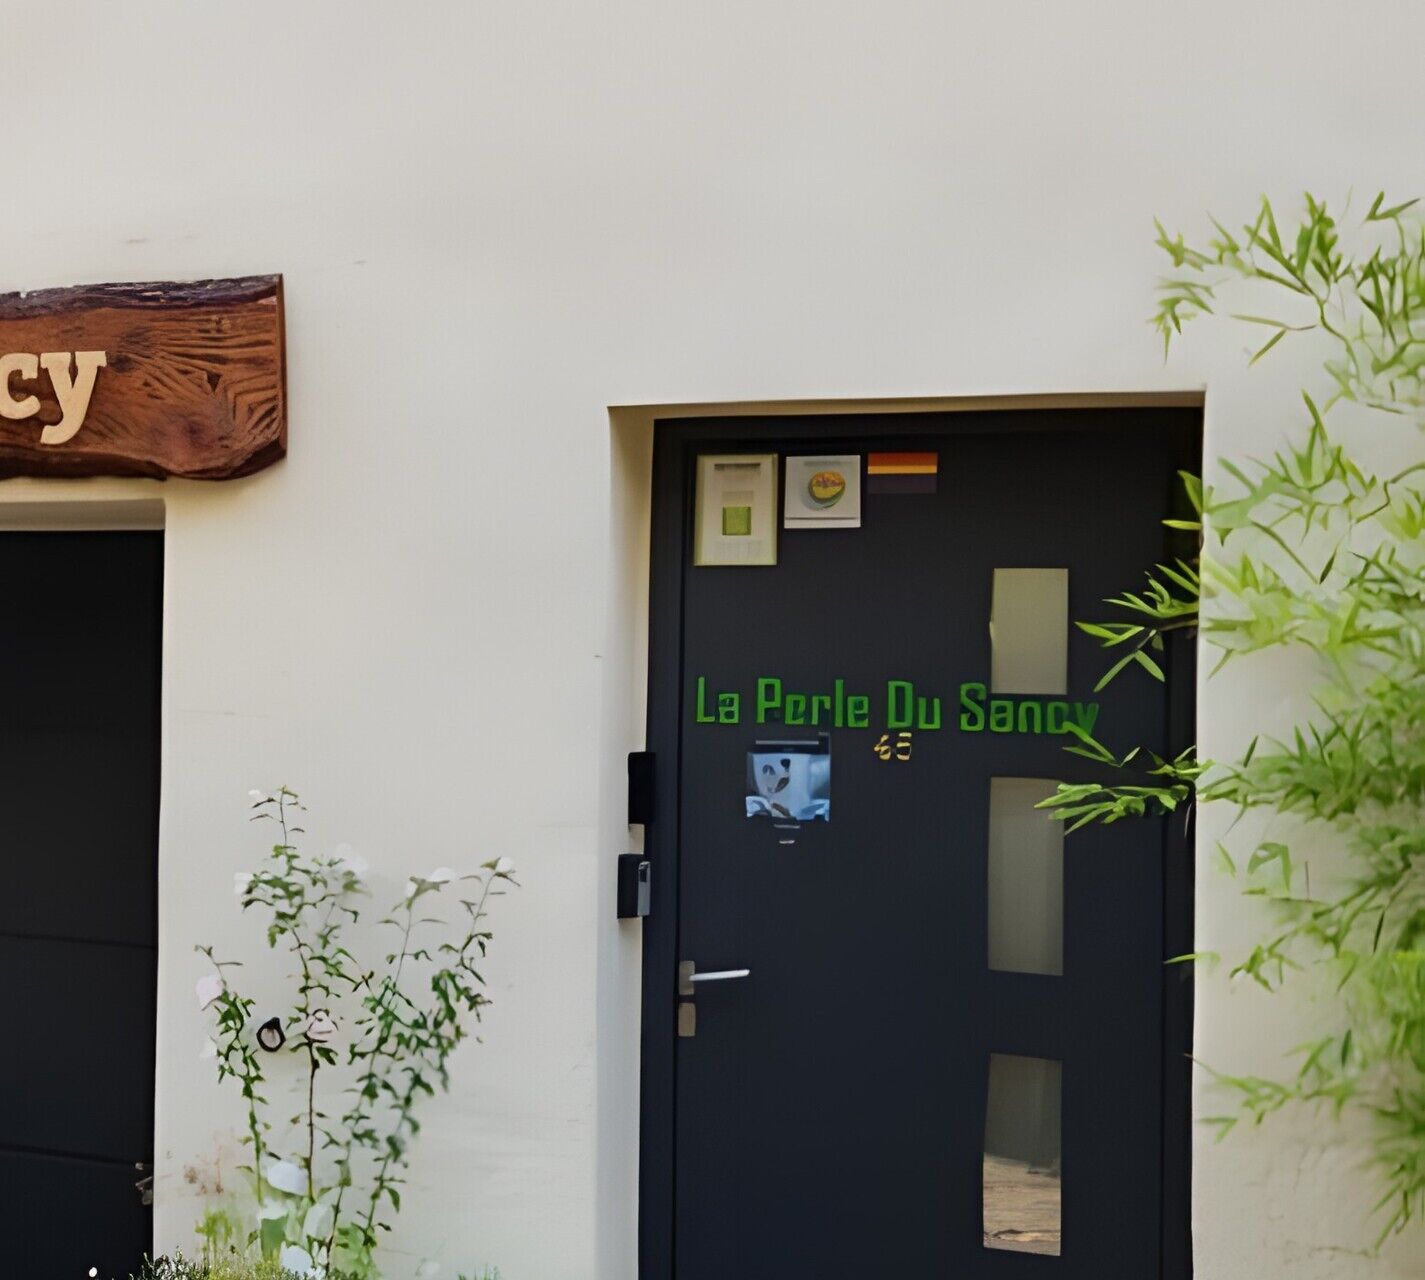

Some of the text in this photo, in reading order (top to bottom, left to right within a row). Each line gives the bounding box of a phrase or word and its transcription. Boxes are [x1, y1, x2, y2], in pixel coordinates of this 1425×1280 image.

[696, 676, 1099, 736] La Perle Du Sancy
